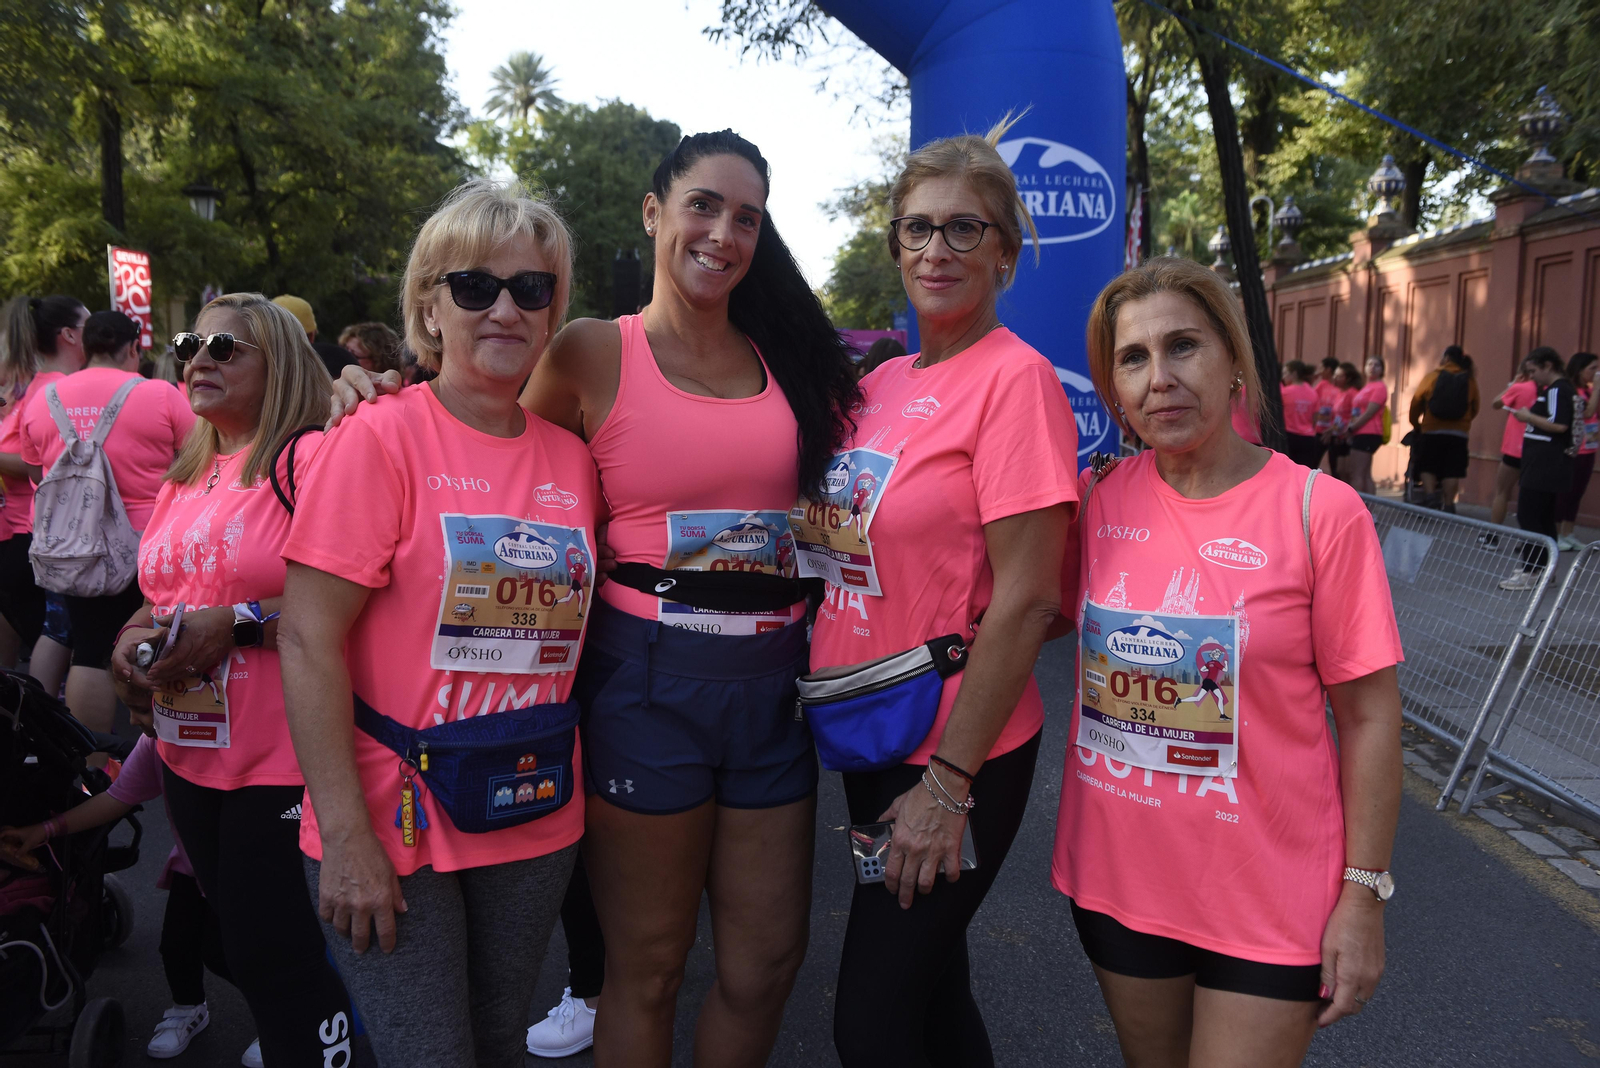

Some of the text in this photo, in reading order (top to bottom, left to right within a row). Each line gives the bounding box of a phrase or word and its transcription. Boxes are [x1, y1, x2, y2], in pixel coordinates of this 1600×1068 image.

[1045, 174, 1104, 189] LECHERA
[1018, 190, 1107, 220] RIANA
[115, 250, 149, 266] SEVILLA
[1069, 396, 1098, 407] HERA
[80, 418, 96, 429] LA
[427, 473, 491, 493] OYSHO
[807, 502, 840, 529] 016
[457, 536, 485, 545] SUMA
[680, 530, 706, 538] SUMA
[1097, 524, 1150, 542] OYSHO
[499, 542, 554, 562] ASTURIANA
[1203, 544, 1262, 566] ASTURIANA
[496, 577, 556, 607] 016
[511, 612, 537, 626] 338
[472, 627, 560, 640] CARRERA DE LA MUJER
[853, 625, 870, 637] 2022
[1085, 623, 1101, 636] SUMA
[1110, 636, 1179, 659] ASTURIANA
[1121, 636, 1176, 647] CENTRAL LECHERA
[448, 646, 503, 662] OYSHO
[228, 671, 249, 680] 2022
[1110, 670, 1179, 705] 016
[1131, 700, 1153, 708] VIOLENCIA
[163, 708, 169, 716] DE
[169, 710, 175, 719] LA
[175, 711, 199, 721] MUJER
[1130, 707, 1156, 723] 334
[1102, 714, 1195, 742] CARRERA DE LA MUJER
[1089, 728, 1125, 752] OYSHO
[1181, 753, 1211, 762] Santander
[1076, 769, 1162, 808] CARRERA DE LA MUJER
[401, 789, 413, 846] PAC-MAN
[1215, 810, 1239, 824] 2022
